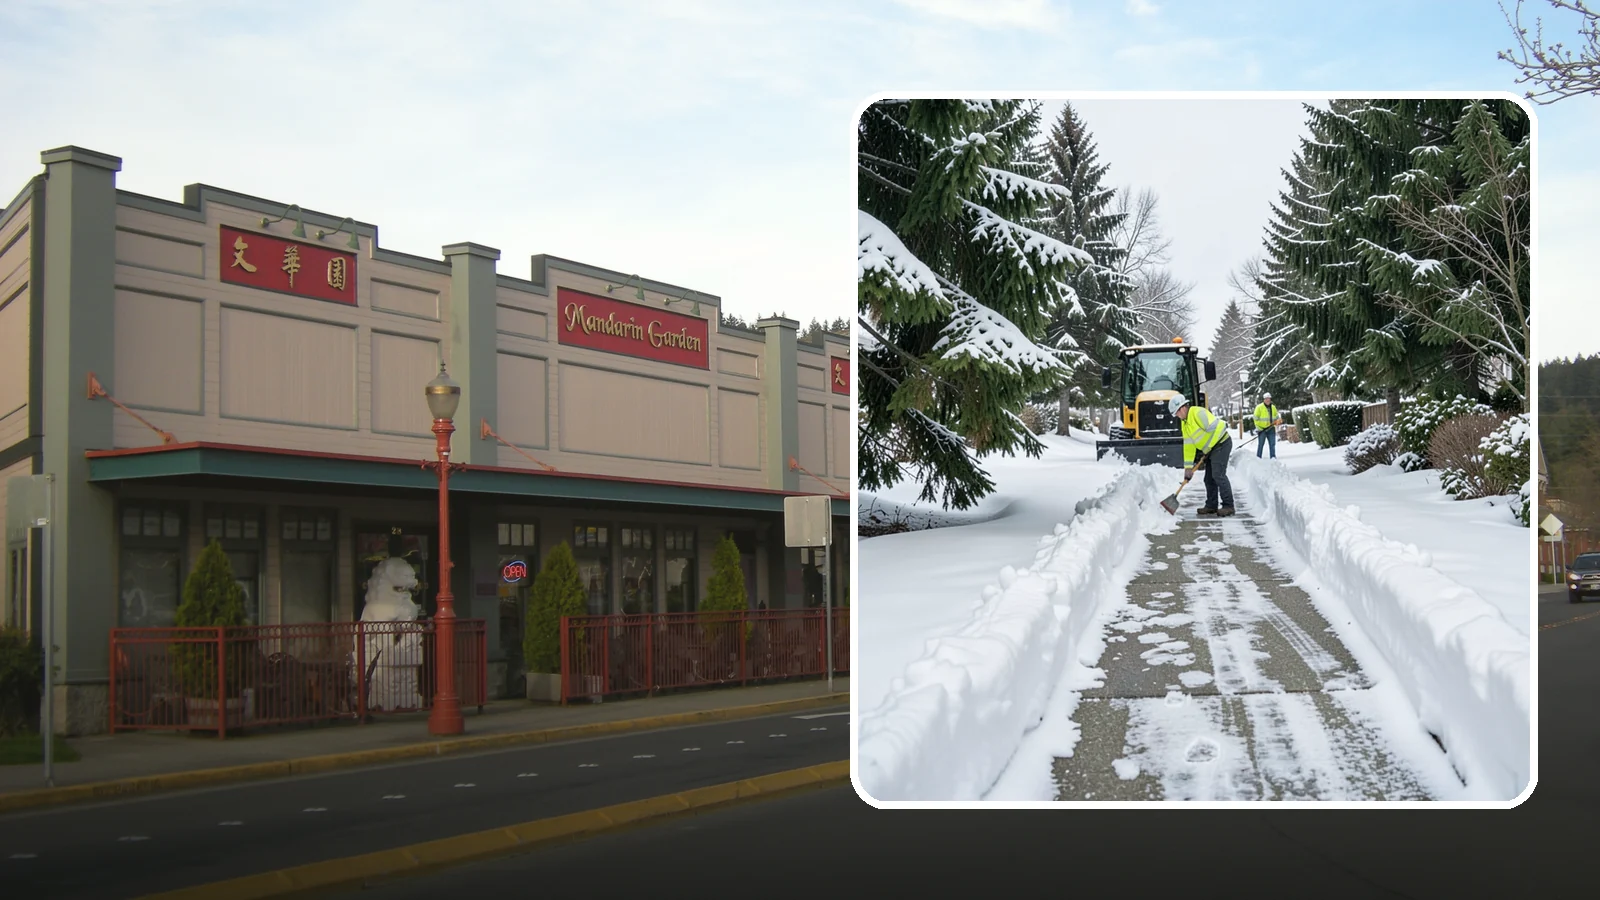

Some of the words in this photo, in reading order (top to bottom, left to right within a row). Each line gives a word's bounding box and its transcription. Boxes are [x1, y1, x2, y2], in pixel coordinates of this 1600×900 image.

[231, 236, 346, 291] 文華園
[564, 302, 644, 341] Mandarin
[648, 320, 701, 352] Garden
[503, 565, 527, 578] OPEN
